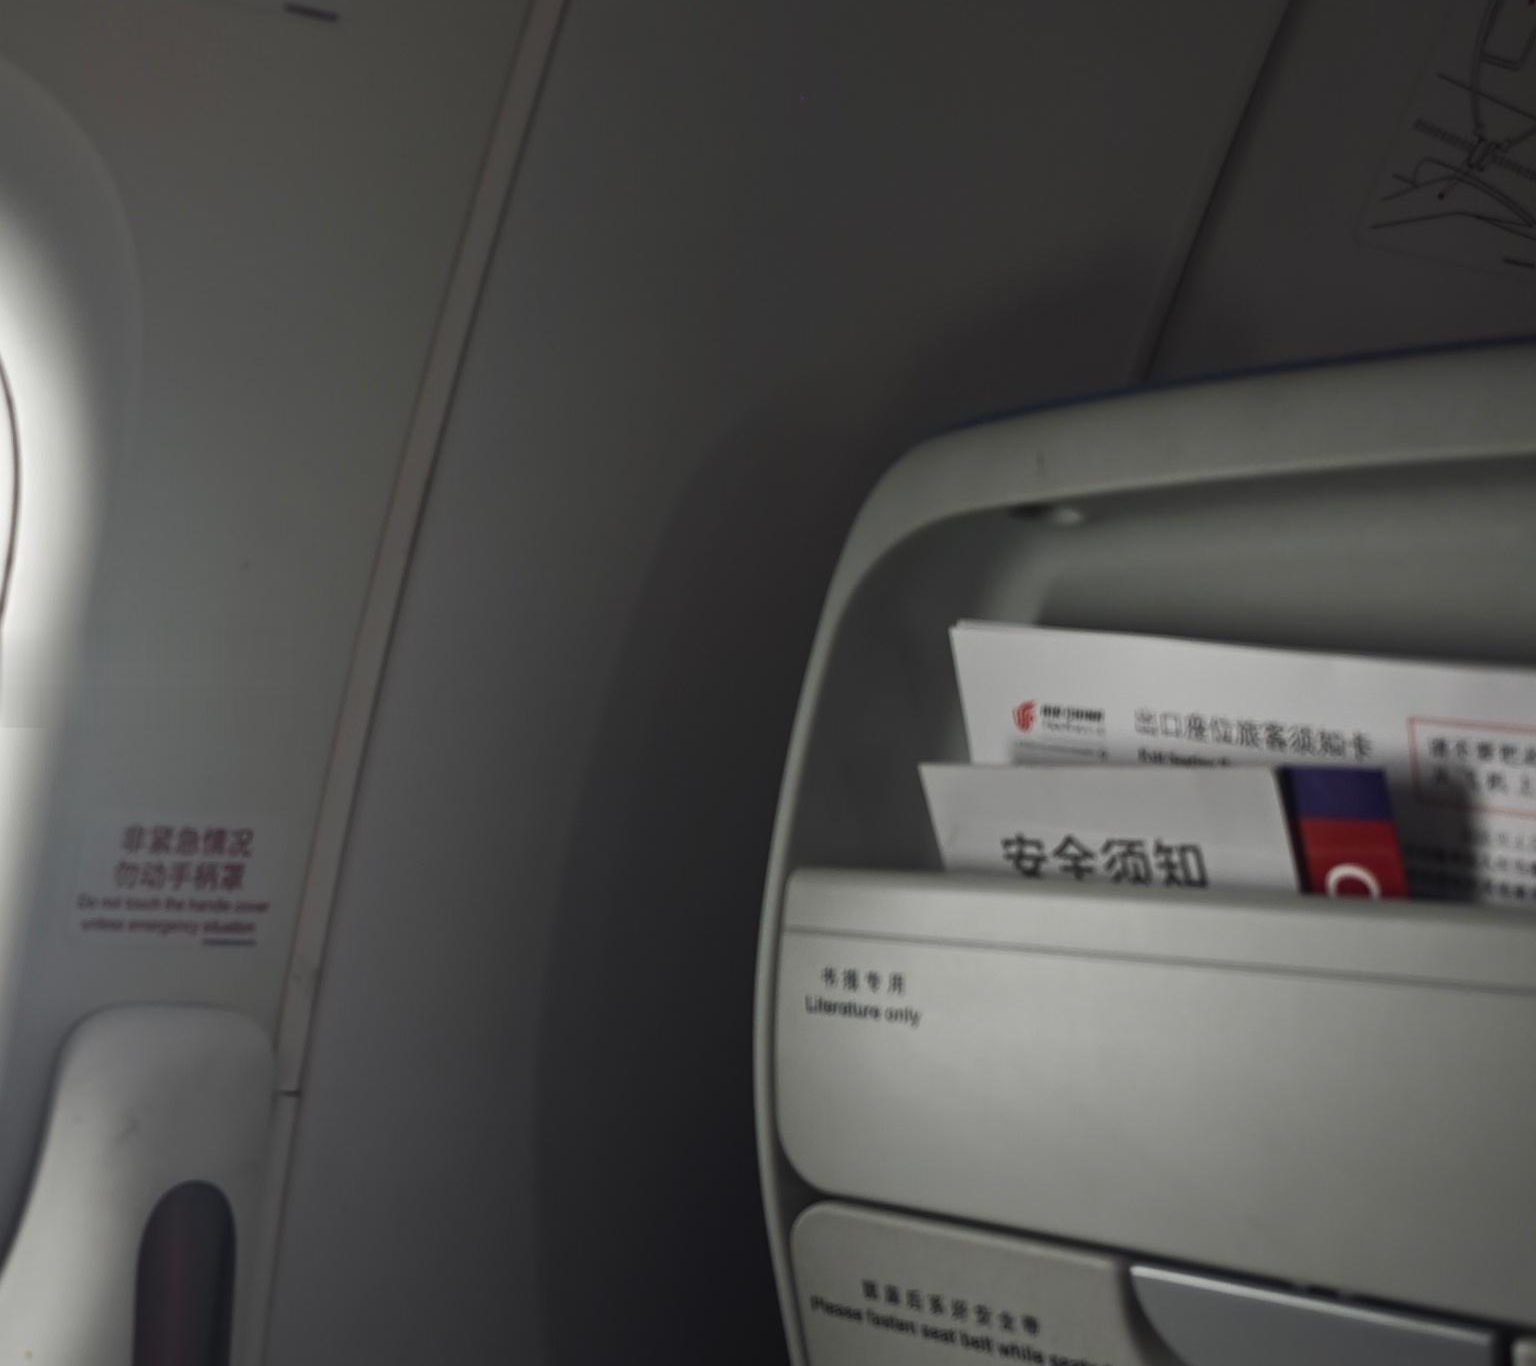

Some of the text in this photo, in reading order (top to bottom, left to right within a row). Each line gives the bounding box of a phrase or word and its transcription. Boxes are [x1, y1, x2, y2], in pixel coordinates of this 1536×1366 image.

[1134, 706, 1373, 760] 出口座位旅客须知卡
[120, 822, 255, 859] 非紧急情况
[1001, 832, 1210, 890] 安全须知
[114, 860, 247, 893] 勿动手柄罩
[805, 994, 922, 1030] Literature only
[810, 1294, 864, 1323] Please
[865, 1307, 916, 1336] fasten
[920, 1322, 958, 1346] seat
[959, 1329, 995, 1355] belt
